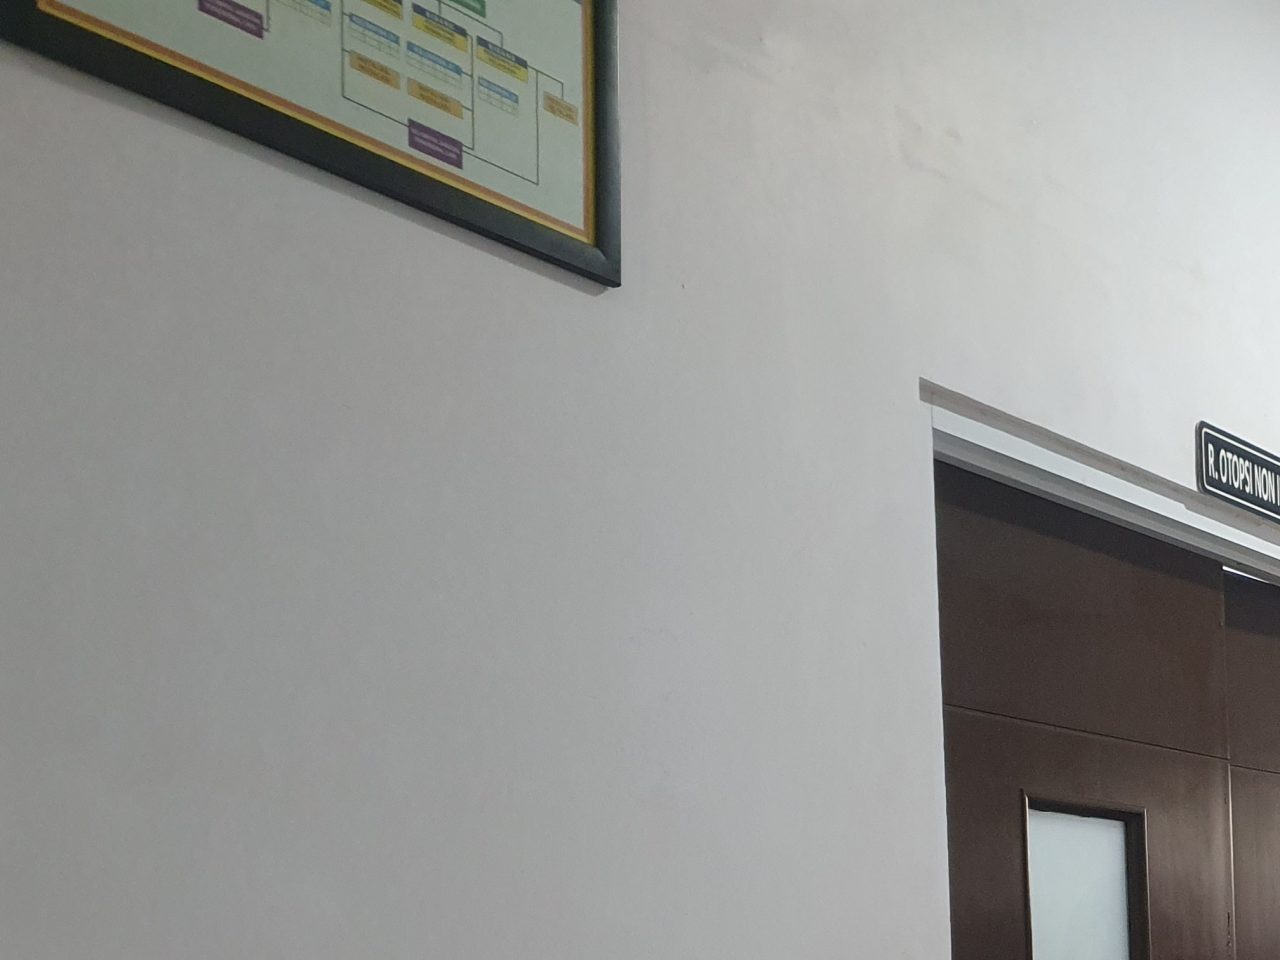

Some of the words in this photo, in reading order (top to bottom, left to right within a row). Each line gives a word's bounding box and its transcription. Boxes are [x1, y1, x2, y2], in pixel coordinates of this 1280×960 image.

[1208, 443, 1218, 480] R.
[1219, 448, 1253, 495] OTOPSI
[1254, 464, 1275, 505] NON
